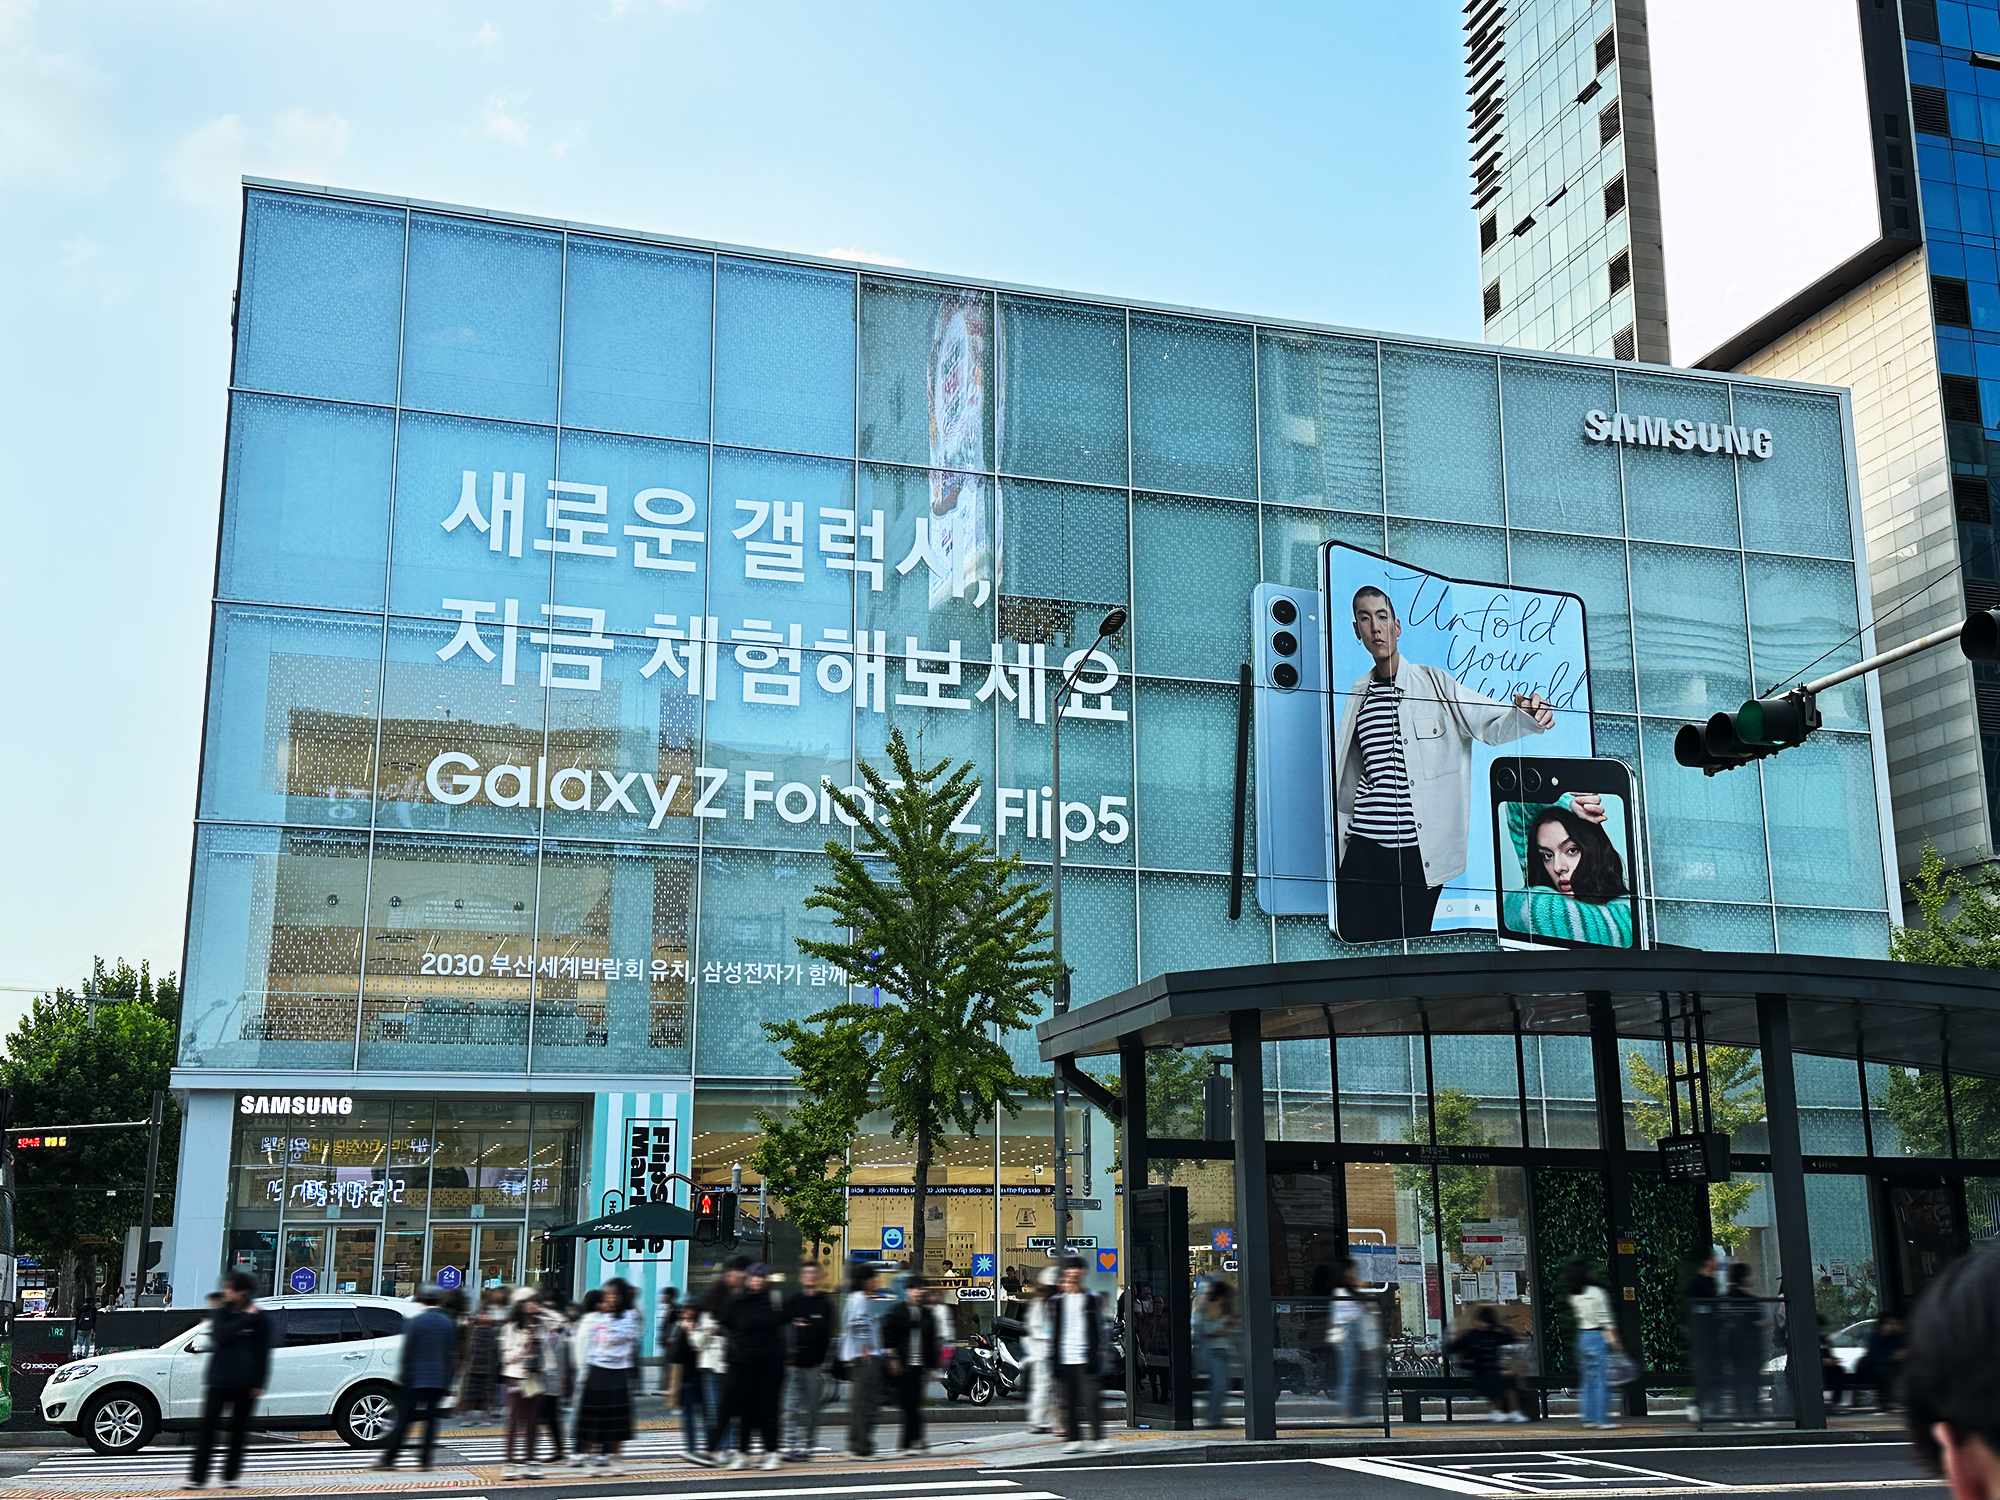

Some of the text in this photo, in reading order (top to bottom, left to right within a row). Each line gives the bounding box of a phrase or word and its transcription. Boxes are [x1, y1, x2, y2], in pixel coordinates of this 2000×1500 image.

[1585, 409, 1774, 459] SAMSUNG
[440, 470, 991, 608] 새로운 갤럭시,
[436, 598, 1128, 724] 지금 체험해보세요
[425, 752, 682, 829] Galaxy
[693, 767, 728, 818] Z
[1000, 786, 1130, 857] Flip5
[420, 953, 484, 976] 2030
[649, 959, 696, 985] 유치,
[703, 961, 803, 985] 삼성전자가
[240, 1096, 353, 1115] SAMSUNG
[1031, 1238, 1094, 1247] WELNESS
[443, 1270, 456, 1280] 24
